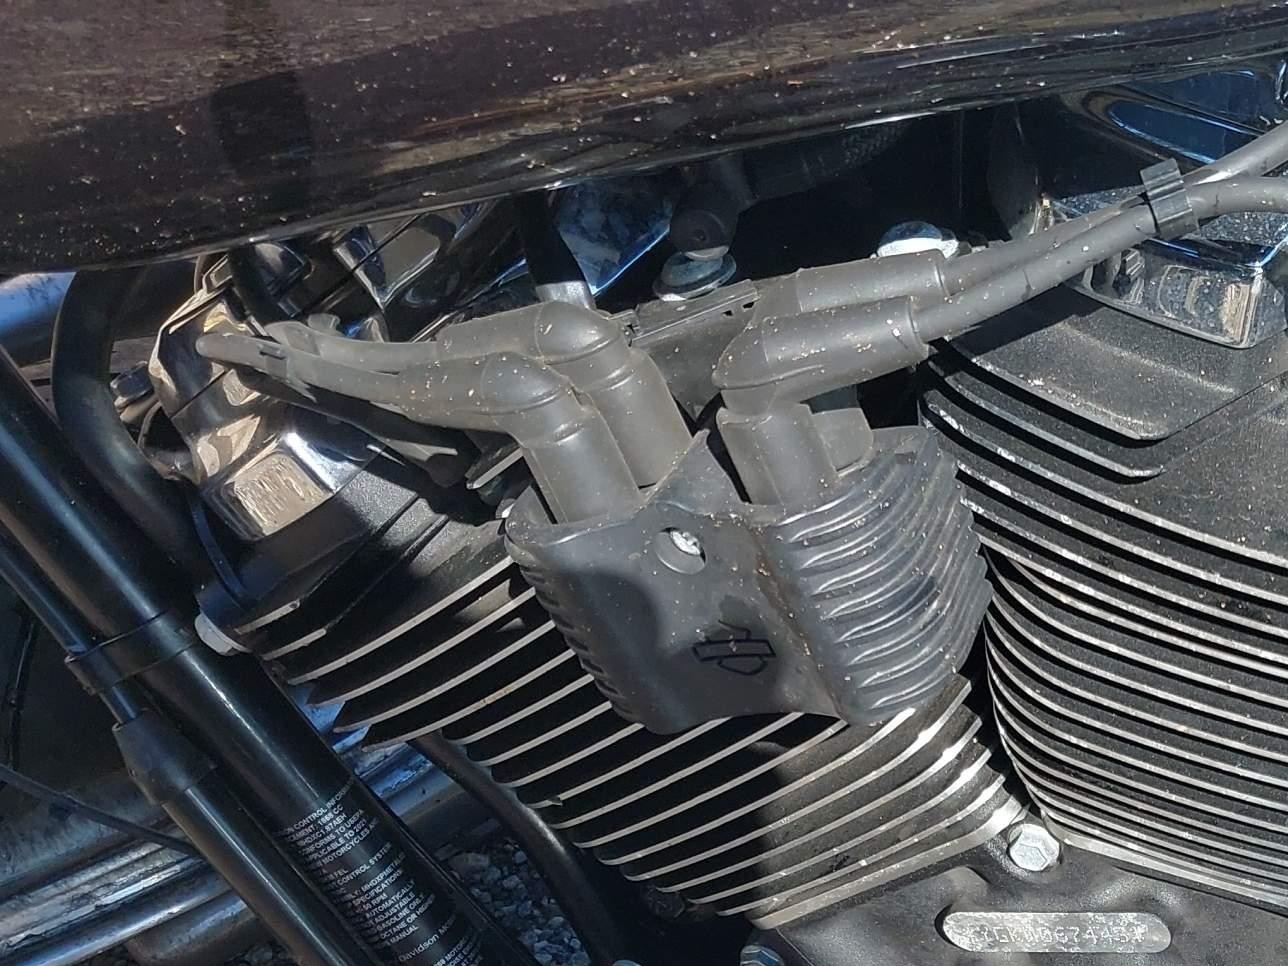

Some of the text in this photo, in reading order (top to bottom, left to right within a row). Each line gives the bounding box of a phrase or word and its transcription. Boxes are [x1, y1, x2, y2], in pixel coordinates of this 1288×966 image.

[292, 783, 351, 830] CONTROL INFORM
[331, 803, 344, 815] CC
[300, 832, 336, 855] ONFORMS
[334, 824, 346, 835] TO
[305, 836, 346, 862] PPLICABLE
[343, 828, 355, 840] TO
[336, 861, 370, 886] CONTROL
[373, 891, 416, 924] ADJUSTABLE
[397, 932, 440, 963] Davidson
